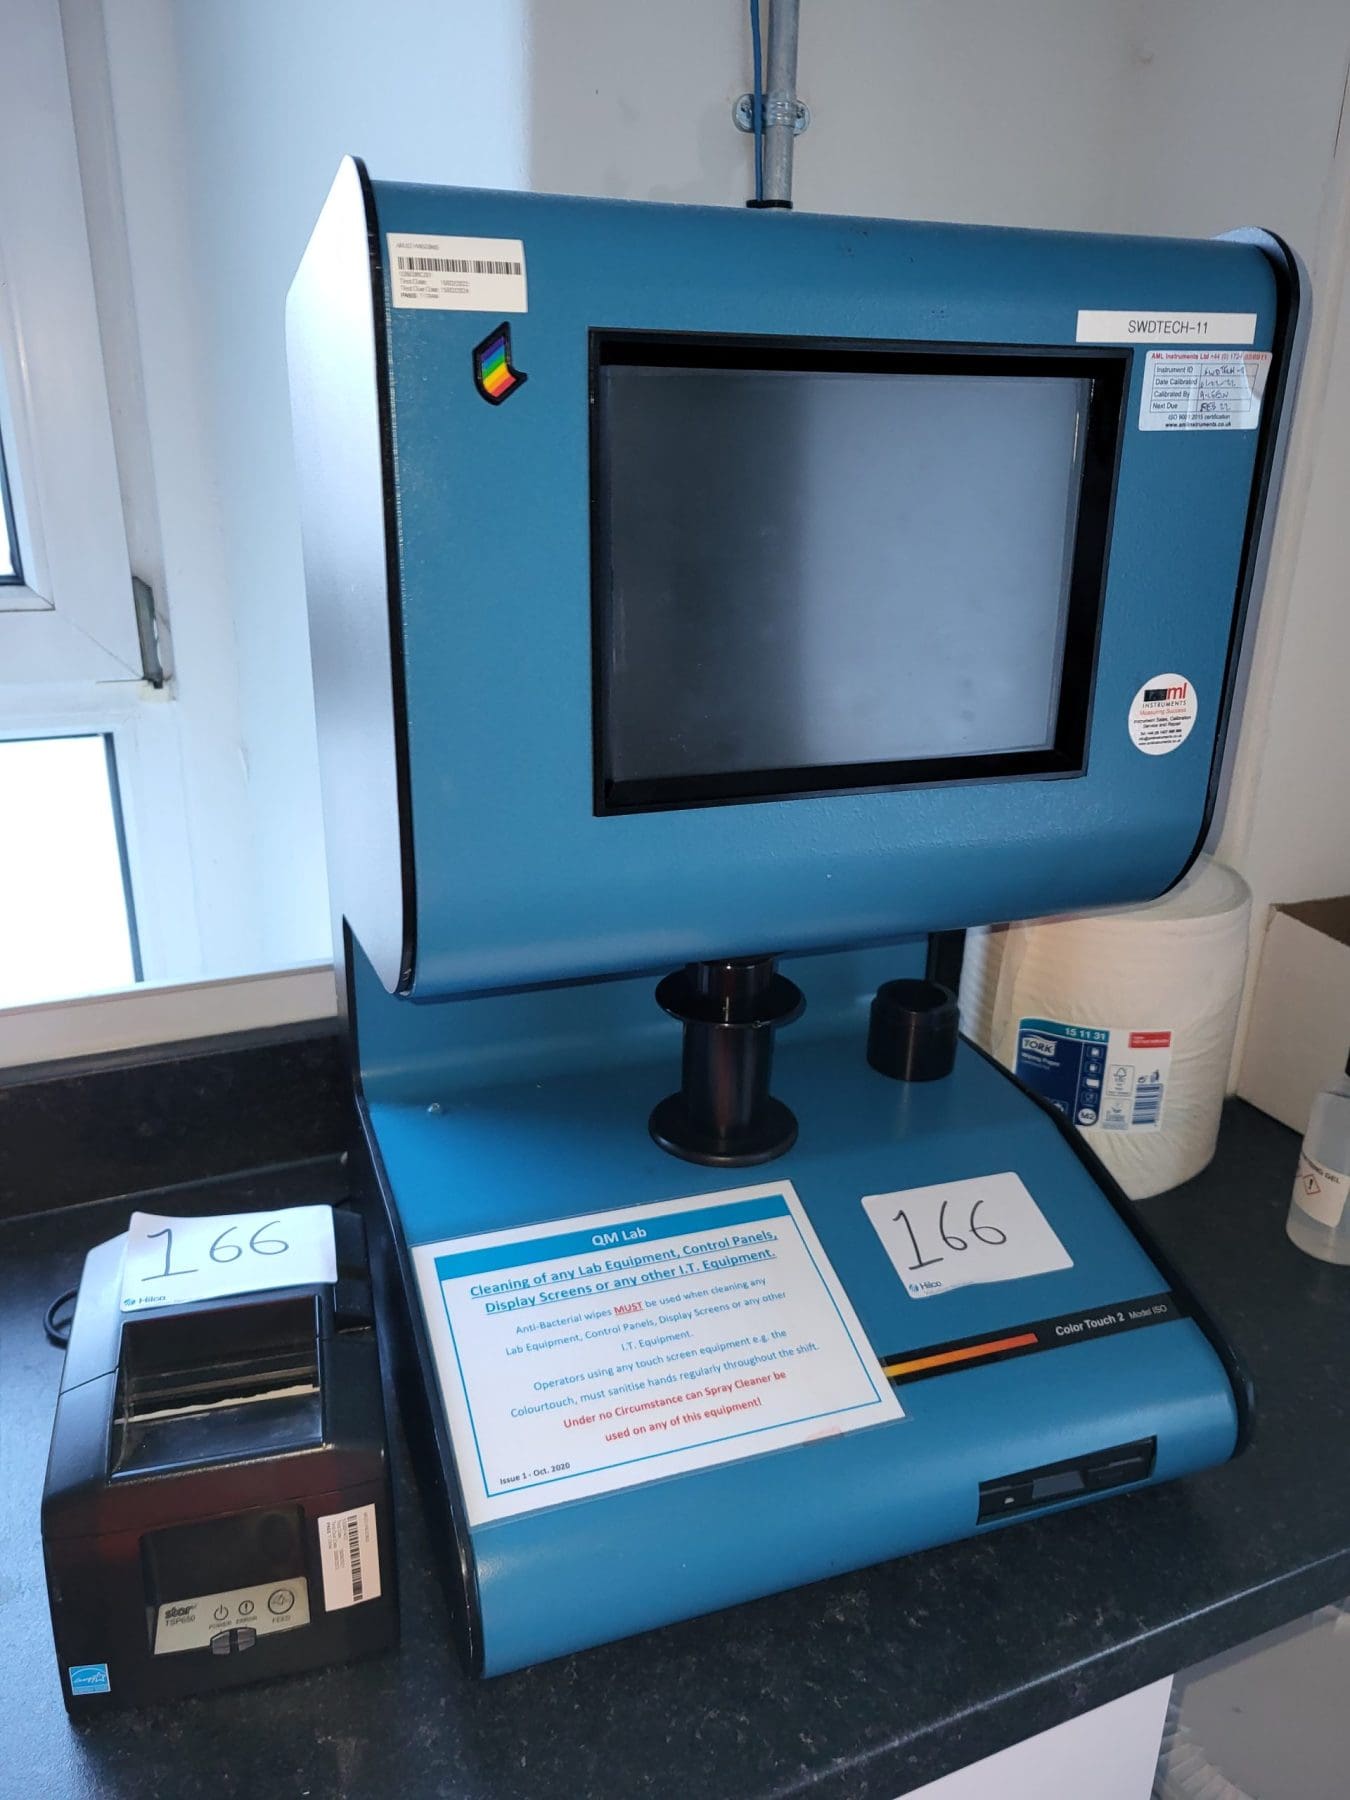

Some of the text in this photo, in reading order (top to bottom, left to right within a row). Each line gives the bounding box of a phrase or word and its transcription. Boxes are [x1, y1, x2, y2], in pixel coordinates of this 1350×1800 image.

[1128, 319, 1208, 335] SWDTECH-11
[1152, 352, 1164, 360] AML
[1183, 391, 1190, 399] By
[1142, 701, 1187, 709] INSTRUMENTS
[1065, 1028, 1106, 1040] 15 11 31
[1023, 1039, 1053, 1053] TORK
[591, 1227, 647, 1247] QM Lab
[892, 1200, 1007, 1270] 166
[141, 1220, 289, 1281] 166
[470, 1230, 778, 1297] Cleaning of any Lab Equipment, Control Panels,
[485, 1249, 776, 1314] Display Screens or any other I.T. Equipment.
[919, 1279, 942, 1290] Hilco
[138, 1295, 167, 1304] Hilco
[515, 1277, 766, 1335] Anti-Bacterial wipes MUST be used when cleaning any
[505, 1291, 787, 1356] Lab Equipment, Control Panels, Display Screens or any other
[1055, 1304, 1168, 1336] Color Touch 2 Model ISO
[621, 1331, 694, 1352] I.T. Equipment.
[533, 1329, 787, 1392] Operators using any touch screen equipment e.g. the
[510, 1343, 820, 1418] Colourtouch, must sanitise hands regularly throughout the shift.
[563, 1370, 786, 1429] Under no Circumstance can Spray Cleaner be
[605, 1397, 762, 1442] used on any of this equipment!
[500, 1474, 521, 1486] Issue
[521, 1472, 528, 1481] 1
[533, 1467, 550, 1478] Oct.
[551, 1462, 571, 1474] 2020
[164, 1605, 193, 1619] star
[272, 1614, 291, 1624] FEED
[208, 1620, 232, 1630] POWER
